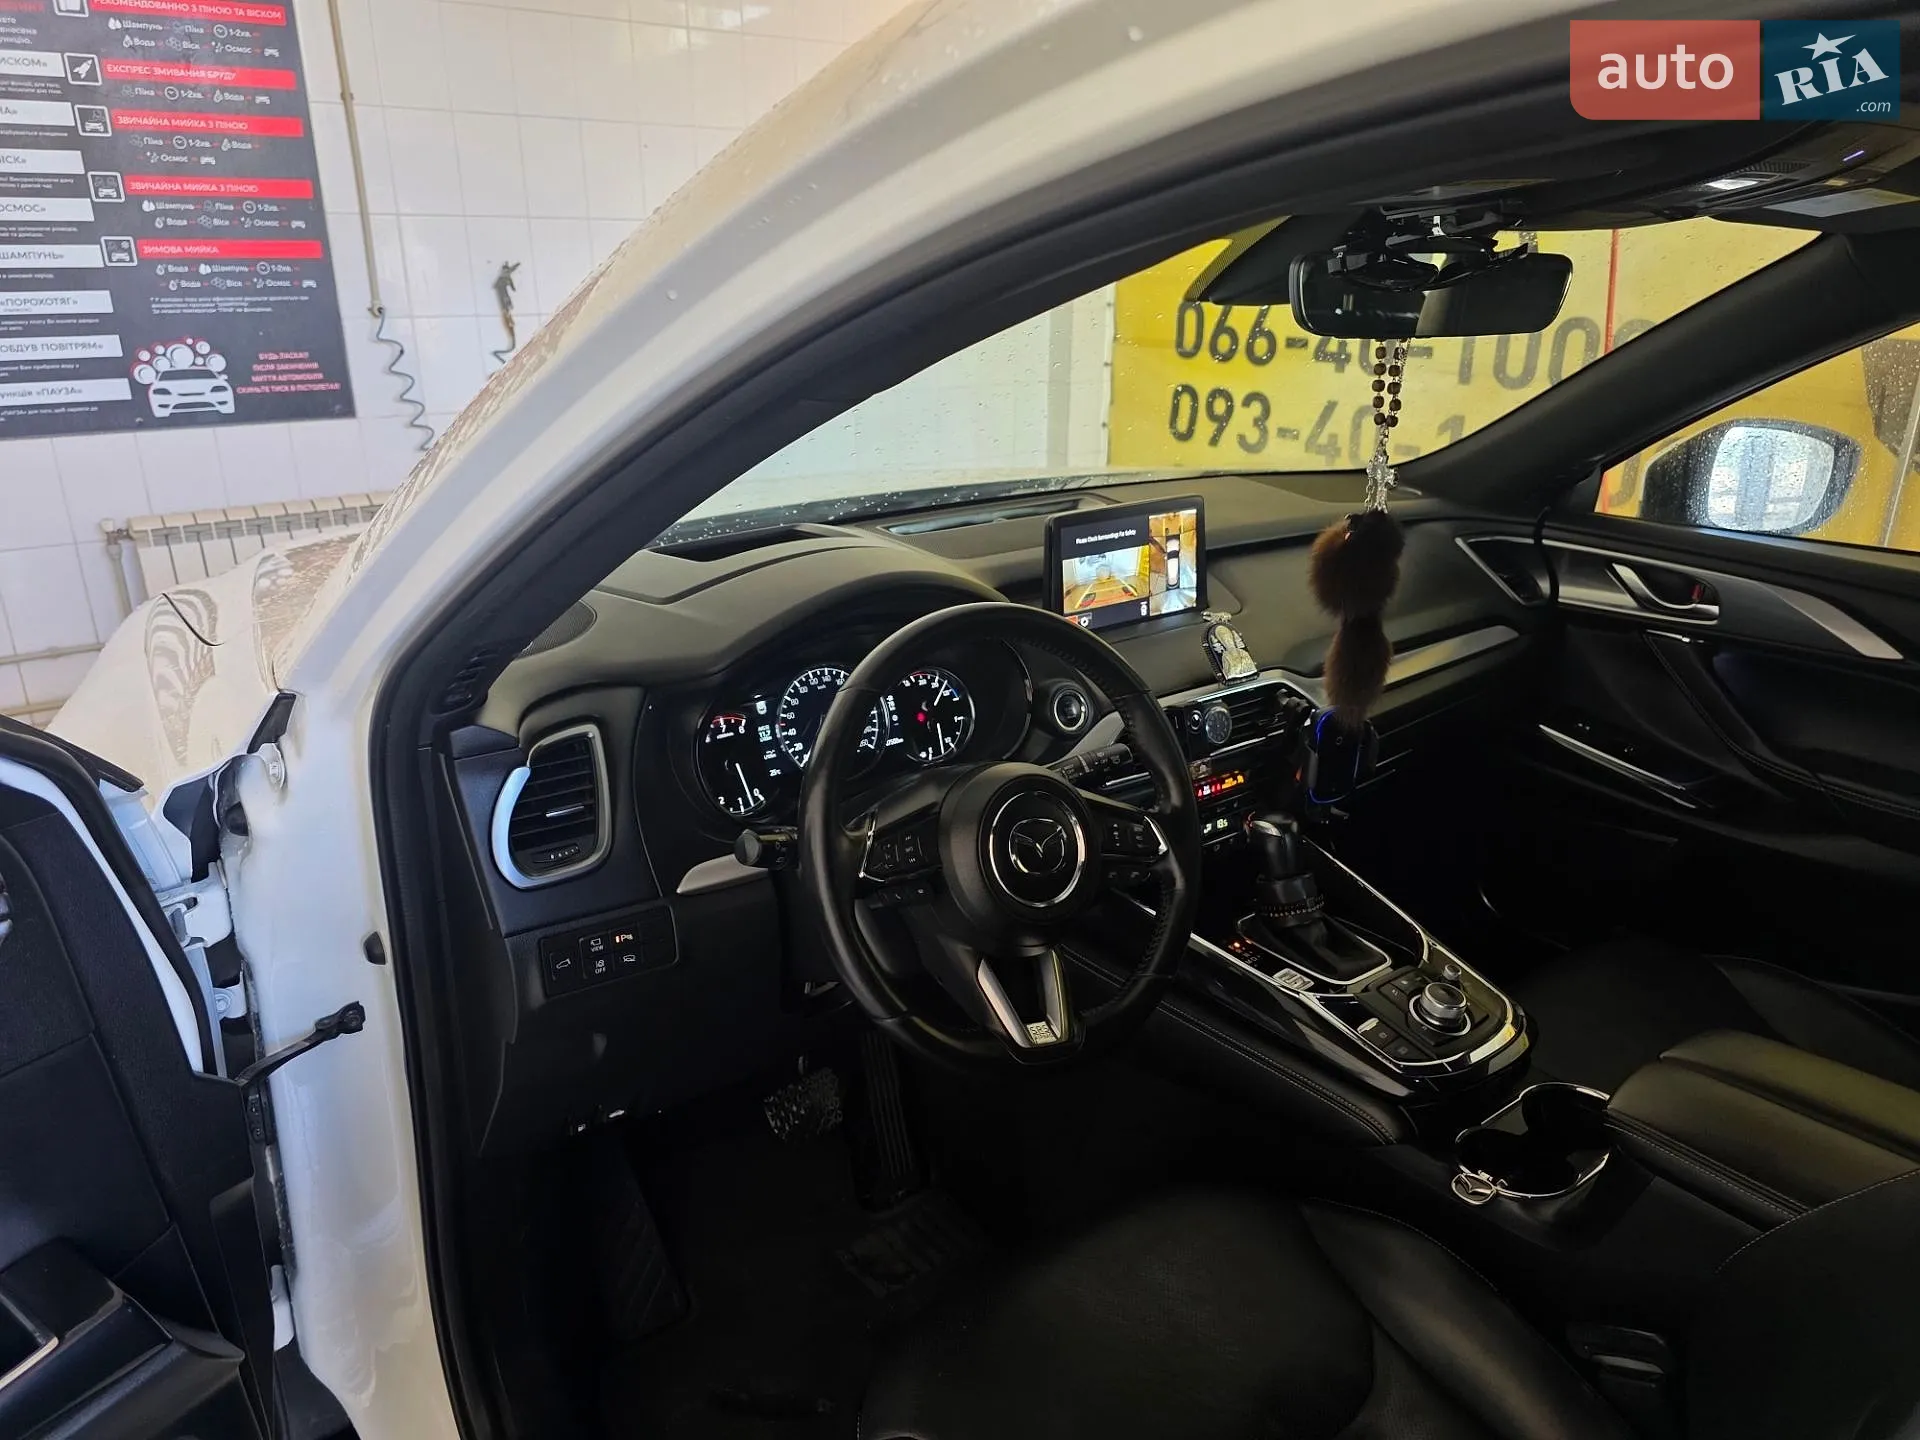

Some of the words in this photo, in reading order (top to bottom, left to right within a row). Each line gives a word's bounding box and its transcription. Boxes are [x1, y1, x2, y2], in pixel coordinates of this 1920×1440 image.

[199, 5, 232, 15] ПІНОЮ
[233, 7, 245, 17] ТА
[246, 9, 281, 19] ВІСКОМ
[122, 19, 163, 31] Шампунь
[185, 24, 204, 34] Піна
[133, 38, 156, 48] Вода
[182, 40, 201, 50] Віск
[225, 44, 252, 54] Осмос
[107, 64, 151, 75] ЕКСПРЕС
[153, 66, 207, 78] ЗМИВАННЯ
[207, 70, 236, 81] БРУДУ
[134, 87, 155, 97] Піна
[224, 92, 245, 101] Вода
[117, 115, 170, 127] ЗВИЧАЙНА
[171, 118, 207, 128] МИЙКА
[215, 121, 248, 131] ПІНОЮ
[143, 137, 164, 146] Піна
[231, 141, 252, 150] Вода
[160, 154, 189, 163] Осмос
[131, 181, 181, 191] ЗВИЧАЙНА
[183, 182, 218, 192] МИЙКА
[226, 184, 259, 194] ПІНОЮ
[156, 202, 195, 211] Шампунь
[166, 218, 188, 226] Вода
[253, 218, 280, 227] Осмос
[143, 246, 184, 255] ЗИМОВА
[184, 245, 219, 255] МИЙКА
[0, 344, 39, 353] ОБДУВ
[1174, 300, 1656, 390] 066-40-100
[738, 725, 746, 734] 8
[788, 728, 797, 736] 40
[794, 742, 803, 751] 20
[718, 796, 725, 804] 2
[594, 967, 606, 975] OFF
